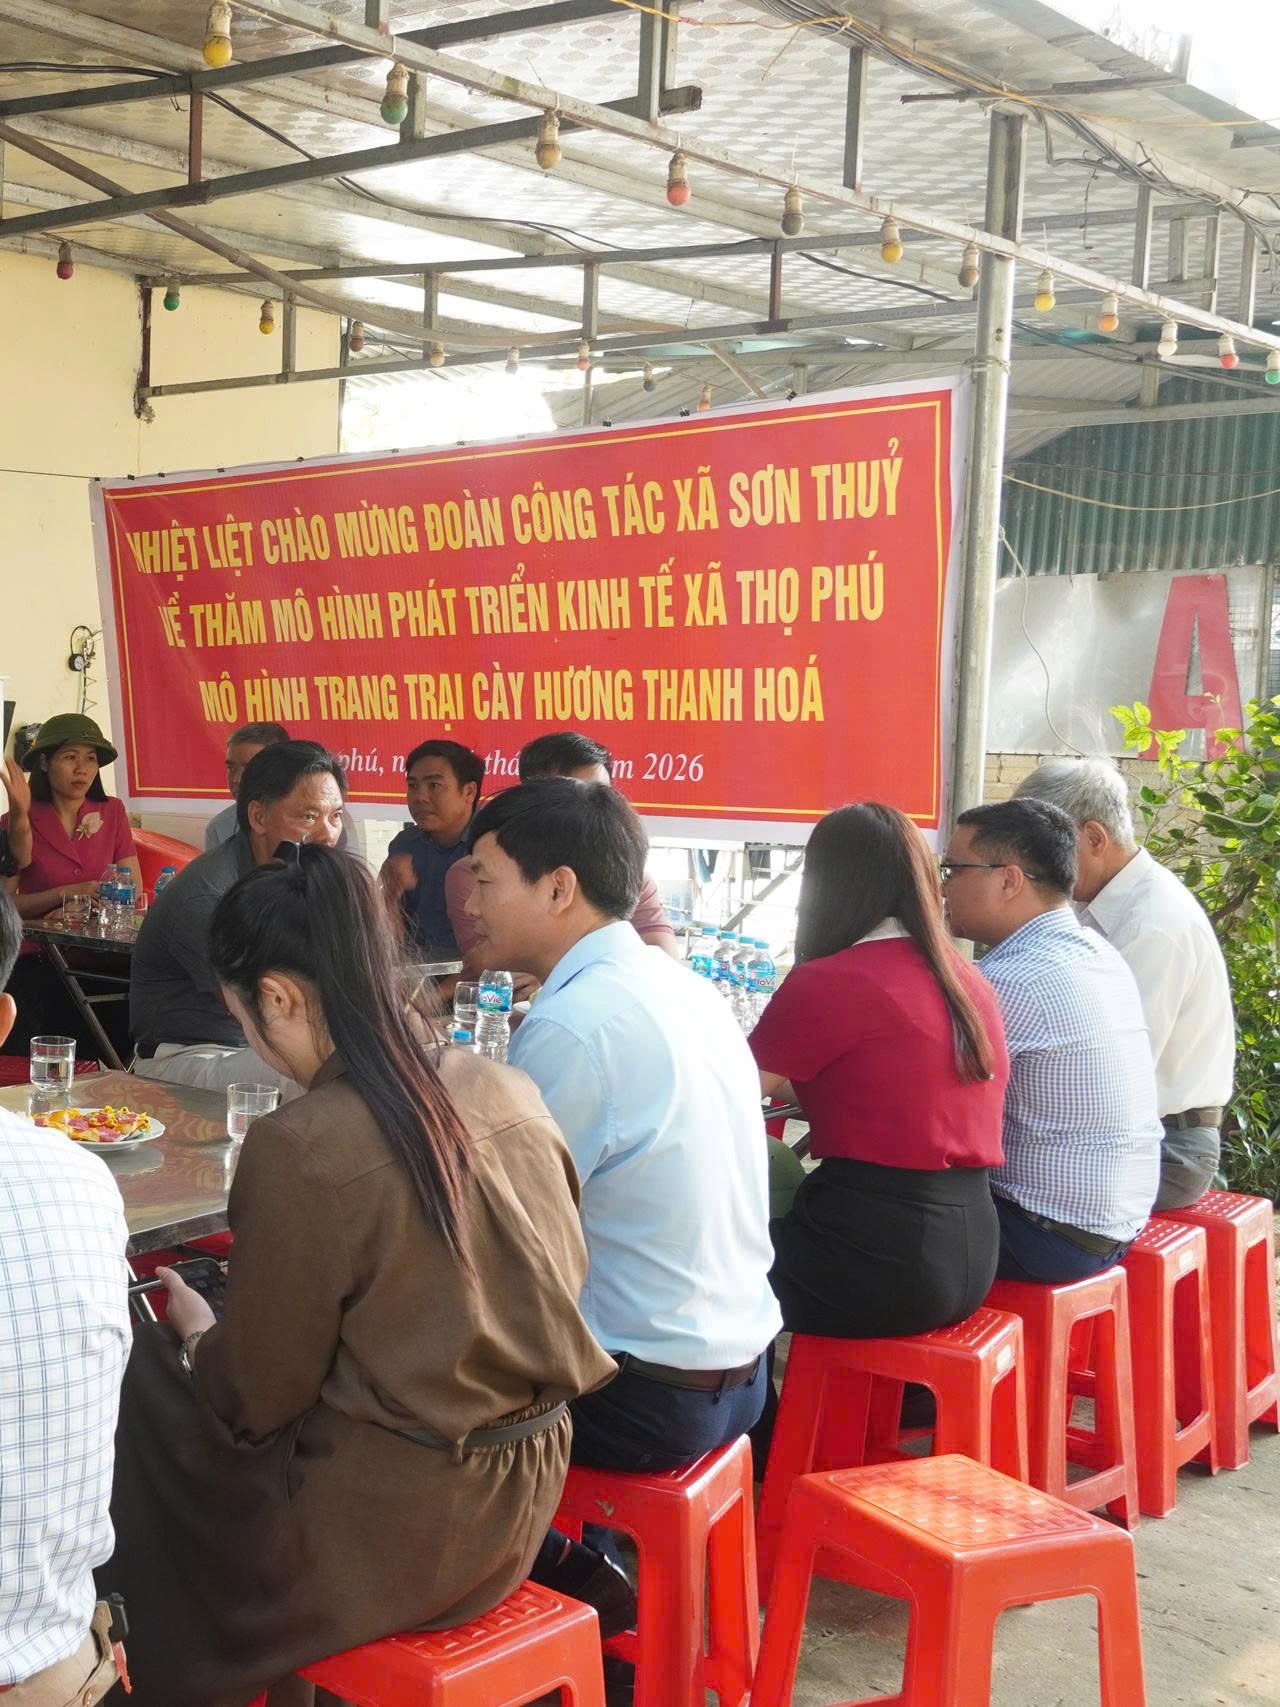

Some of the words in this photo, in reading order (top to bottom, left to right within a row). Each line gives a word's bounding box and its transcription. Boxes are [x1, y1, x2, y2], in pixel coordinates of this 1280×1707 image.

[203, 514, 253, 577] LIỆT
[261, 506, 330, 565] CHÀO
[334, 499, 419, 559] MỪNG
[424, 489, 505, 551] ĐOÀN
[511, 481, 597, 546] CÔNG
[602, 472, 665, 537] TÁC
[673, 465, 719, 532] XÃ
[729, 464, 801, 528] SƠN
[811, 437, 903, 522] THUỶ
[189, 592, 267, 648] THĂM
[271, 587, 314, 643] MÔ
[318, 585, 383, 641] HÌNH
[387, 579, 457, 639] PHÁT
[464, 562, 549, 635] TRIỂN
[557, 577, 631, 631] KINH
[639, 557, 676, 628] TẾ
[684, 561, 728, 627] XÃ
[736, 567, 800, 636] THỌ
[811, 550, 885, 622] PHÚ
[199, 672, 238, 723] MÔ
[244, 668, 310, 722] HÌNH
[314, 674, 397, 721] TRANG
[404, 673, 465, 732] TRẠI
[472, 662, 524, 721] CÀY
[534, 665, 633, 722] HƯƠNG
[642, 667, 744, 722] THANH
[754, 655, 824, 722] HOÁ
[484, 749, 521, 776] thá
[641, 753, 704, 782] 2026
